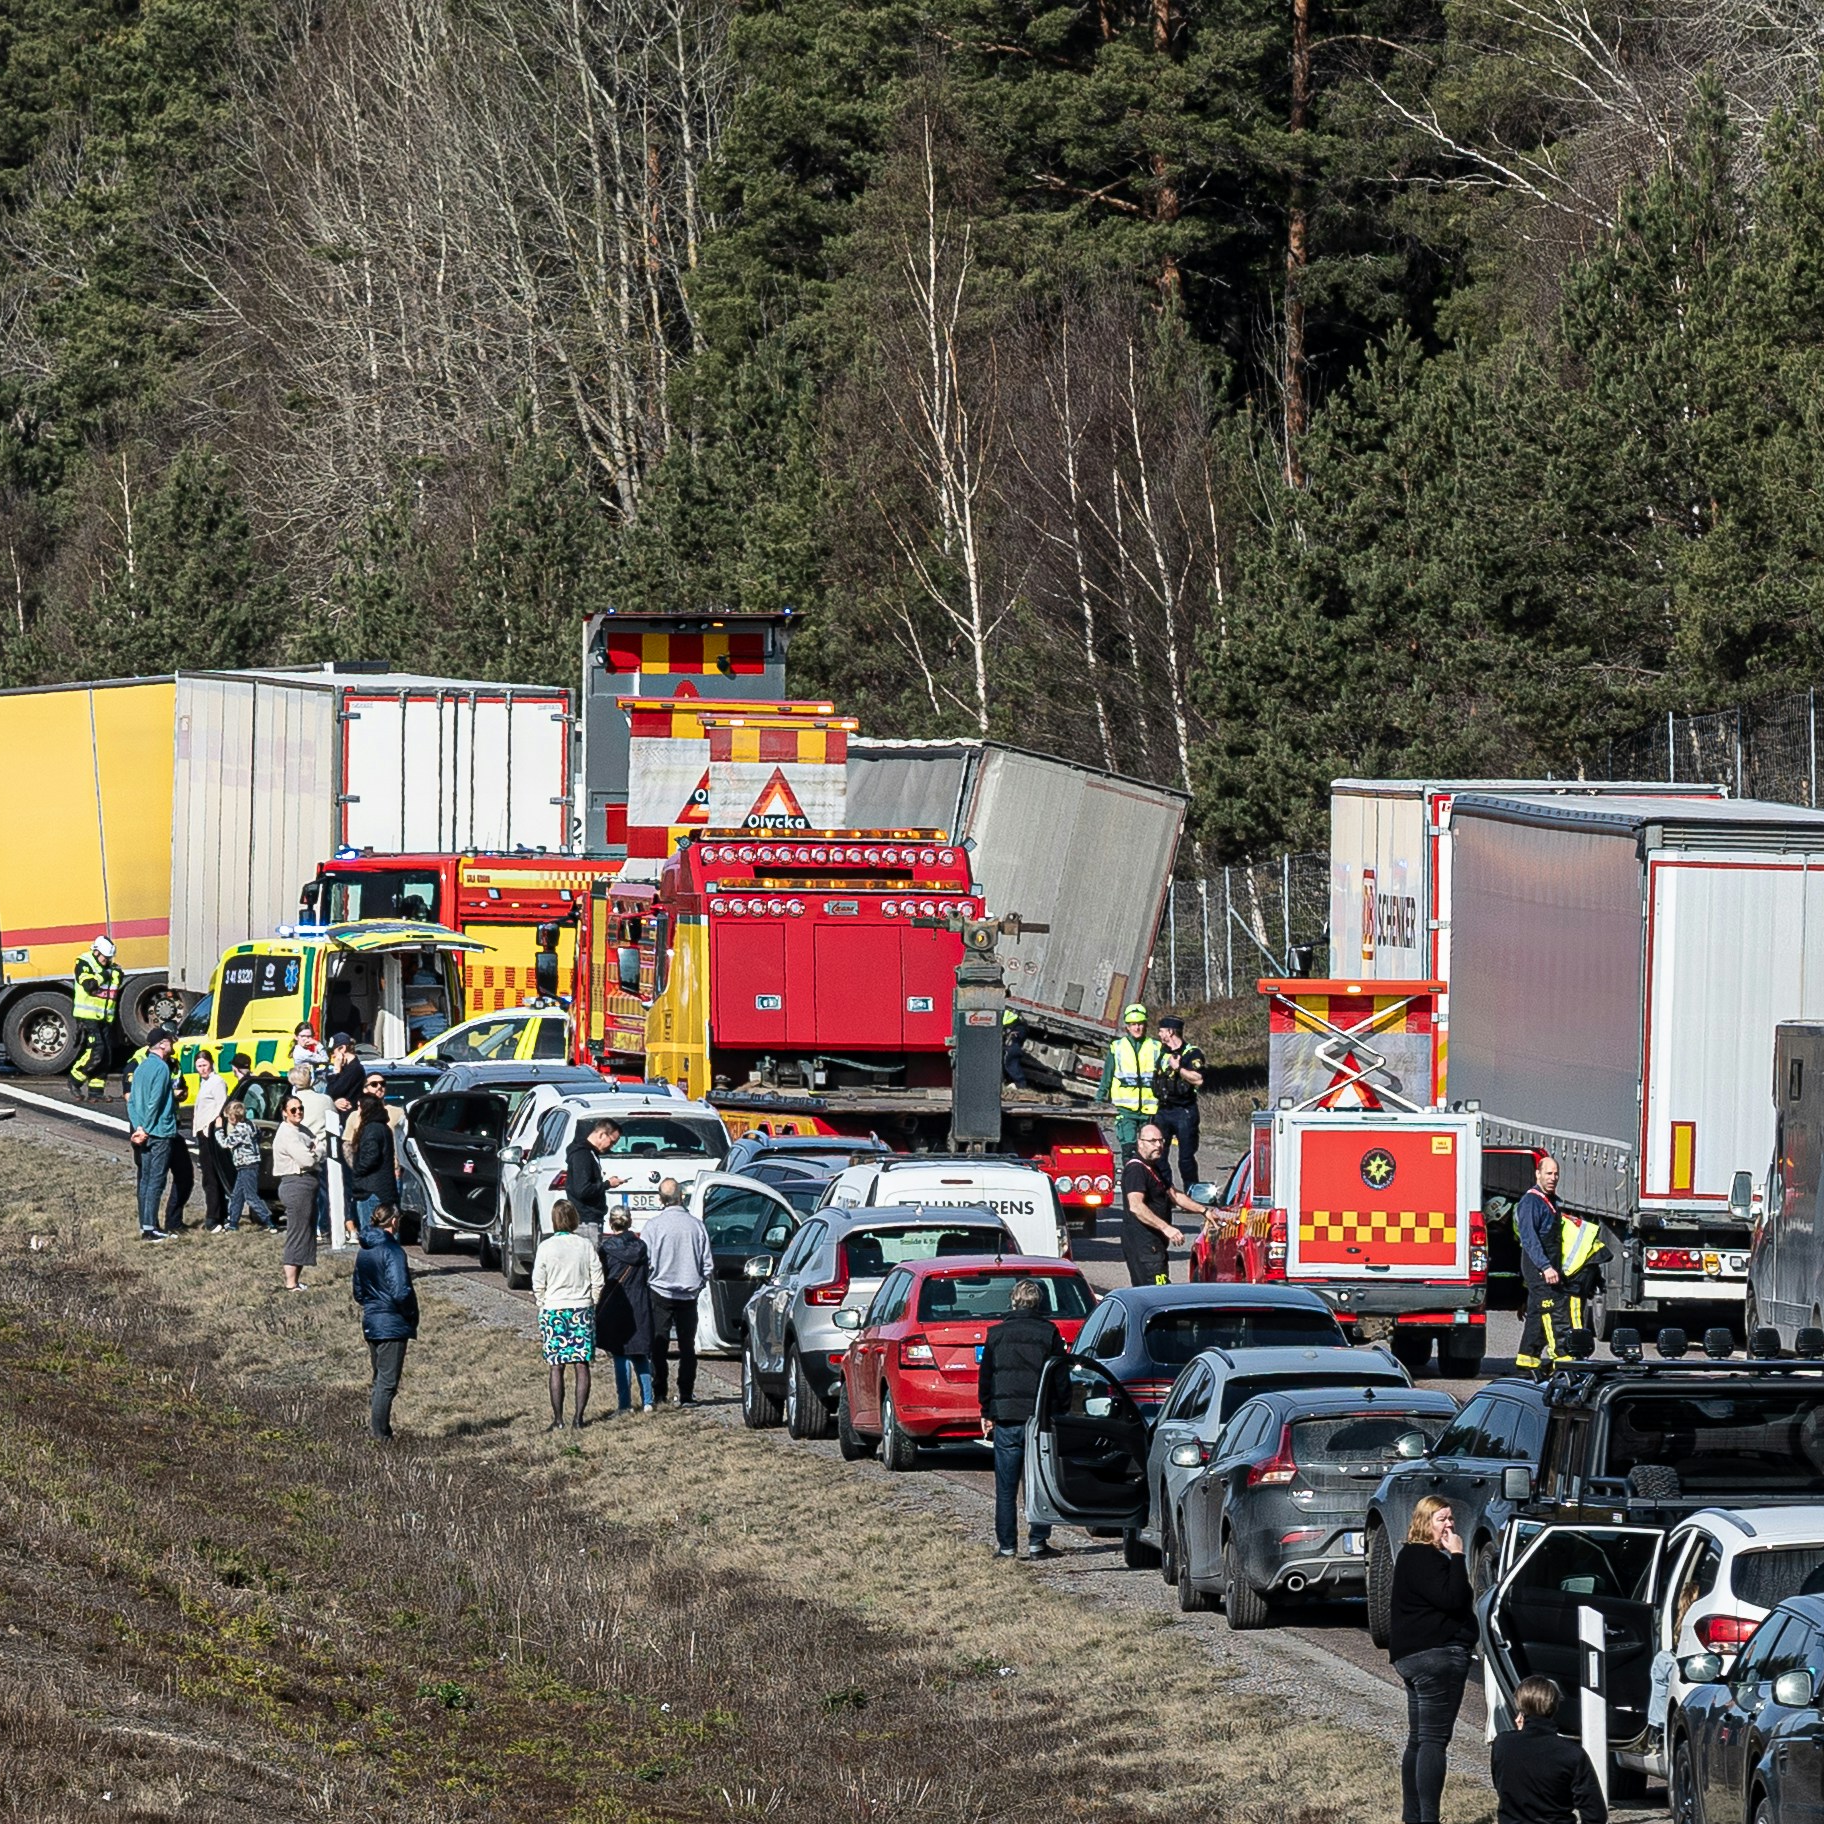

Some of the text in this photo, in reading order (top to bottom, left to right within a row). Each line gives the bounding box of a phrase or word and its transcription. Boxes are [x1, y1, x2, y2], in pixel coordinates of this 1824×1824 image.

[746, 815, 806, 829] Olycka
[1377, 893, 1417, 950] SCHENKER
[632, 1195, 655, 1206] SDE
